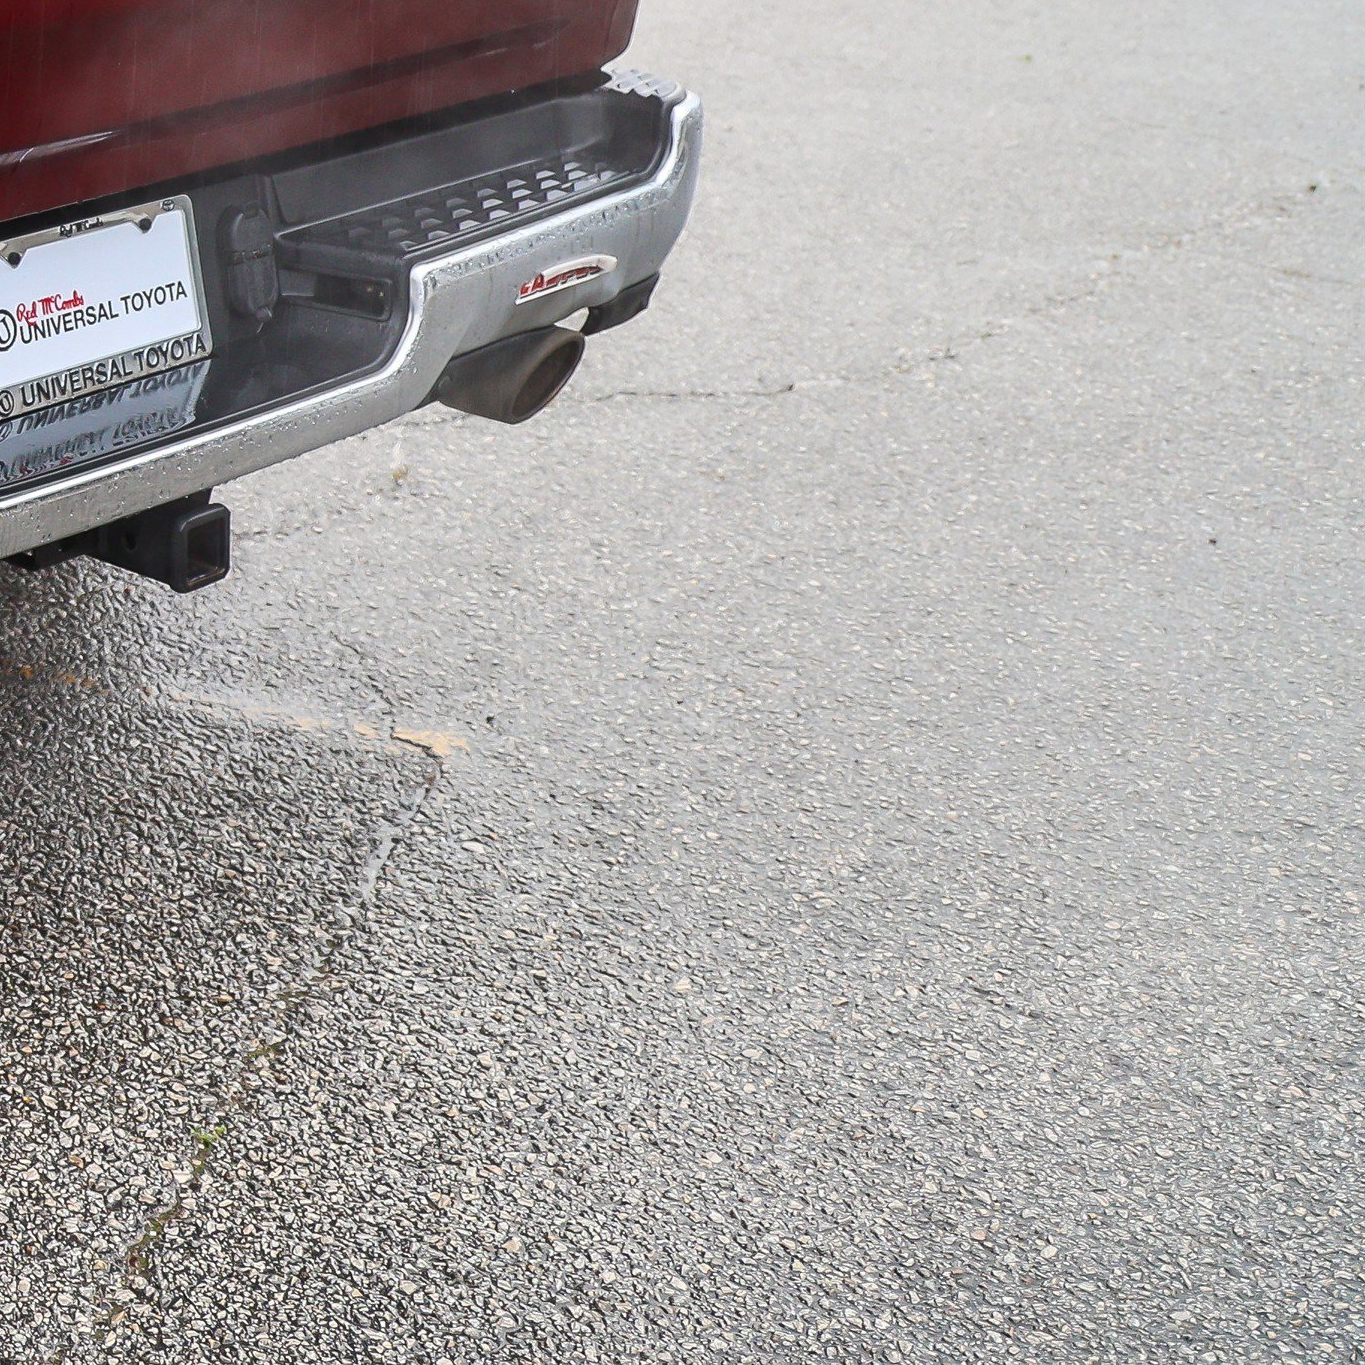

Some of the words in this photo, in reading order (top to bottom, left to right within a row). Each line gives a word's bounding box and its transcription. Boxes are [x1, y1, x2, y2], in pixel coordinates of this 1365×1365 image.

[16, 300, 37, 327] Red
[19, 300, 120, 345] UNIVERSAL
[120, 280, 188, 315] TOYOTA
[21, 360, 133, 408] UNIVERSAL
[134, 333, 206, 372] TOYOTA
